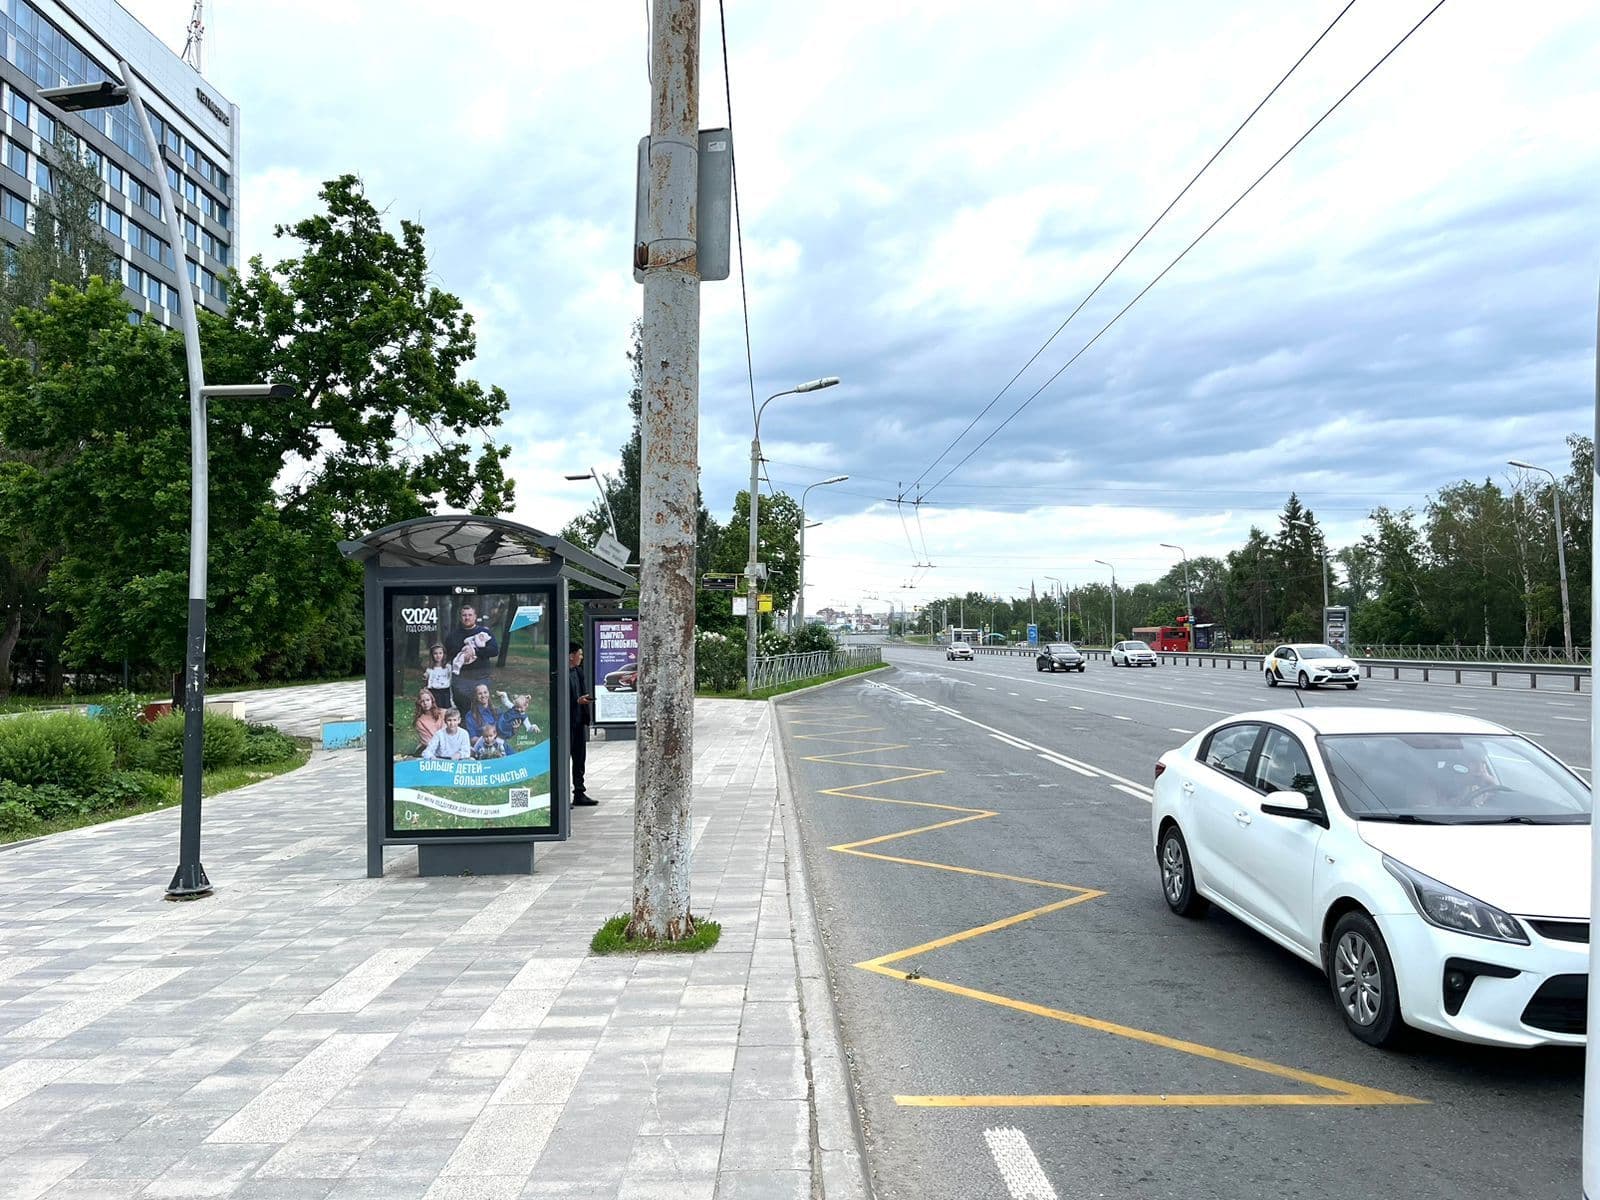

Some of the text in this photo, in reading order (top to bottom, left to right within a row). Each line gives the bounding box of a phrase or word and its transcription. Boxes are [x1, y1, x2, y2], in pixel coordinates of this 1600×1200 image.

[401, 608, 437, 624] 2024
[600, 639, 639, 649] АВТОМОБИЛЬ
[420, 761, 454, 773] БОЛЬШЕ
[456, 763, 482, 774] ДЕТЕЙ
[454, 768, 528, 785] БОЛЬШЕ СЧАСТЬЯ!
[405, 809, 420, 821] 0+
